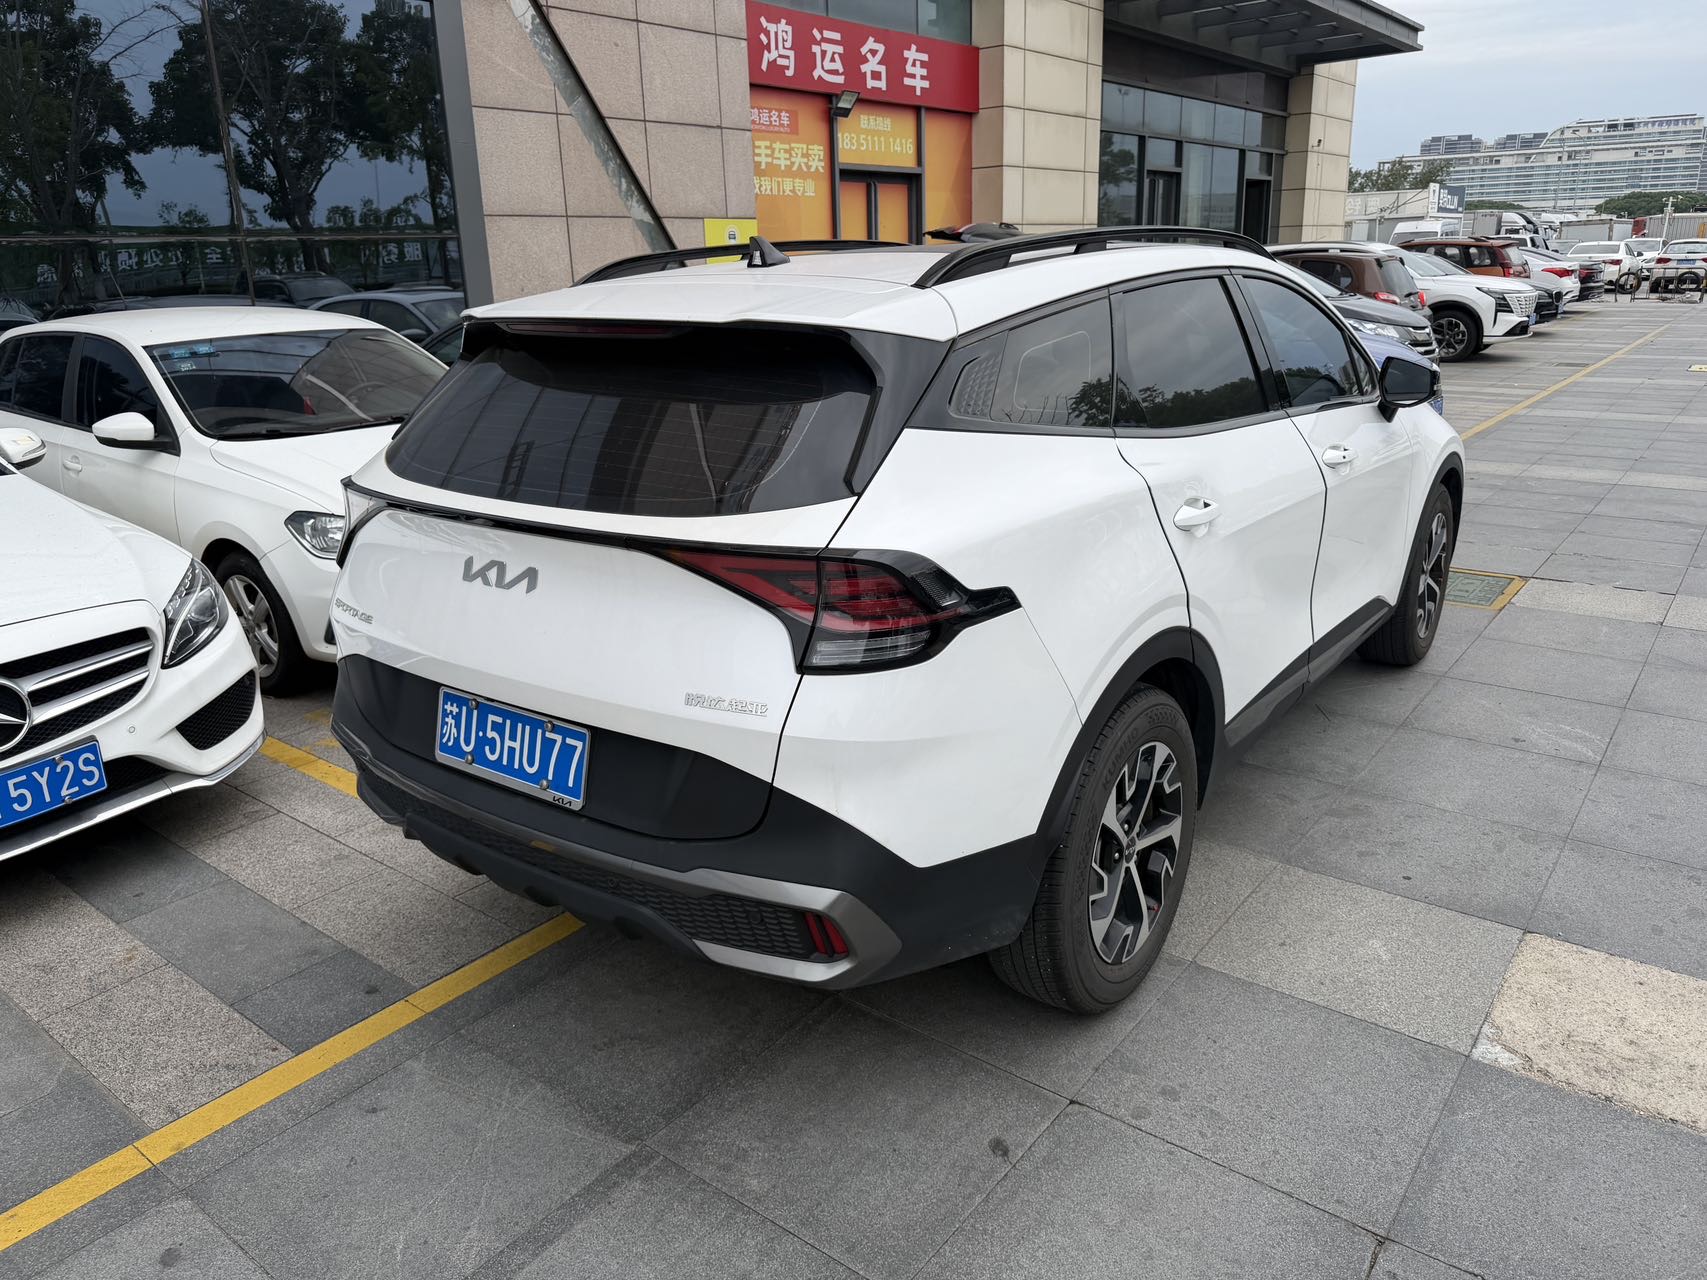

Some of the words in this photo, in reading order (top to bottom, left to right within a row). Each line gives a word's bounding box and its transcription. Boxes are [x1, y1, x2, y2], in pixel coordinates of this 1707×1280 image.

[758, 15, 930, 96] 鸿运名车
[838, 132, 857, 151] 183
[860, 134, 885, 153] 5111
[889, 136, 914, 155] 1416
[462, 555, 539, 594] KIA
[0, 752, 100, 819] 5Y2S
[553, 795, 572, 807] KIA
